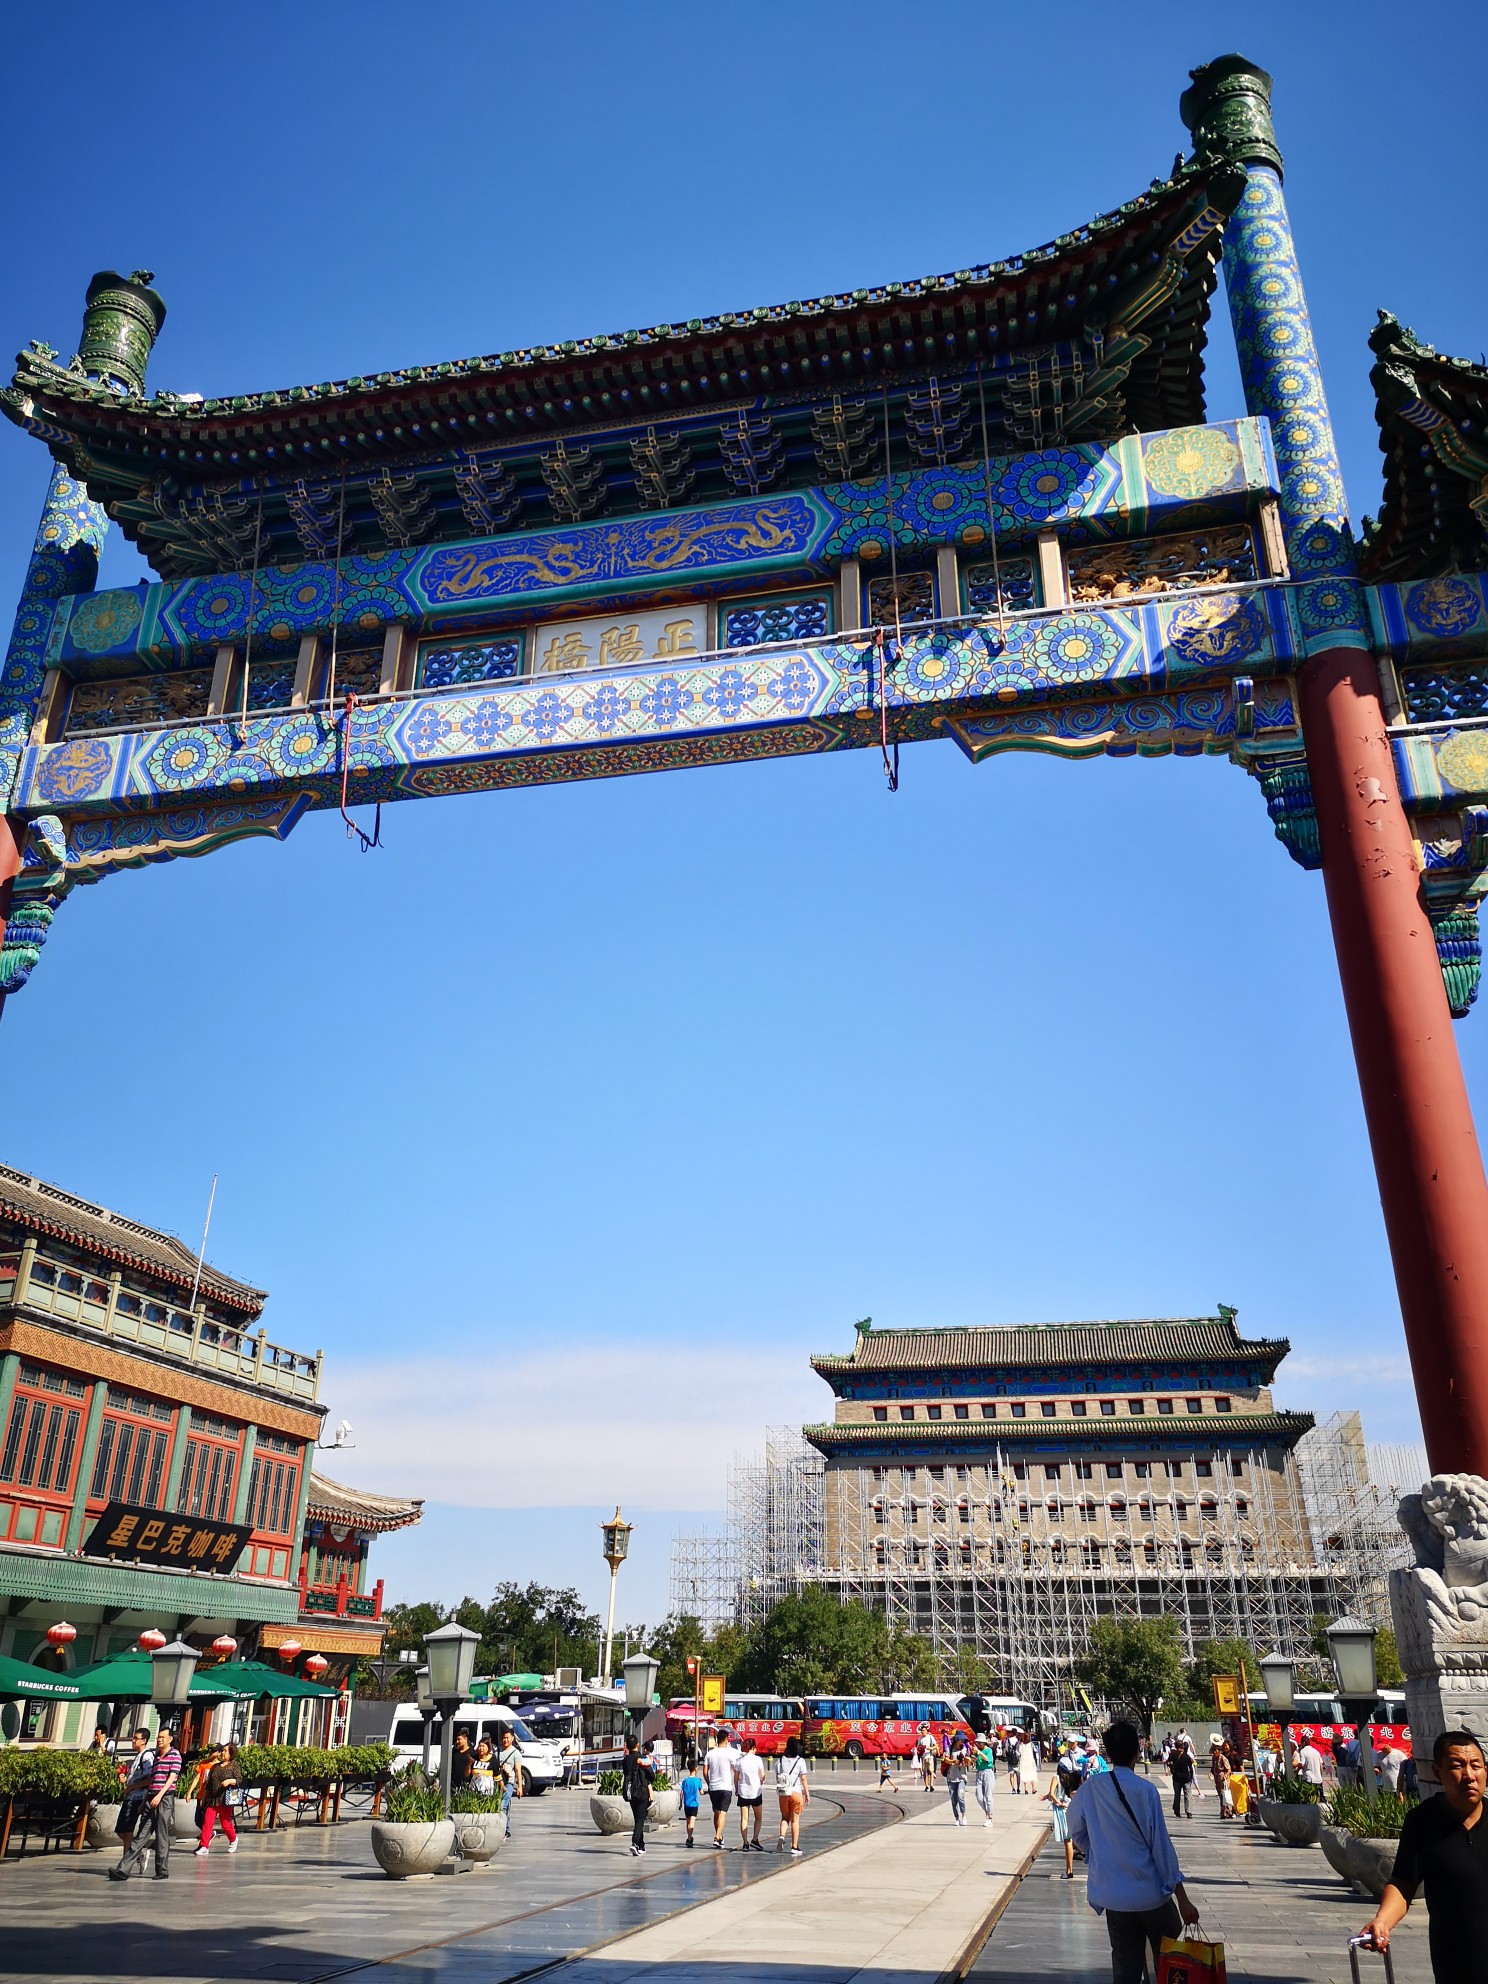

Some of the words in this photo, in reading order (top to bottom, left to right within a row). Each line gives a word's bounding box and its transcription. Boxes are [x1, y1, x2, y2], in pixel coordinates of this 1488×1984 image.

[106, 1514, 238, 1563] 星巴克咖啡
[17, 1680, 54, 1691] STARBUCKS
[54, 1685, 80, 1693] COFFEE
[473, 1760, 491, 1770] LAZY
